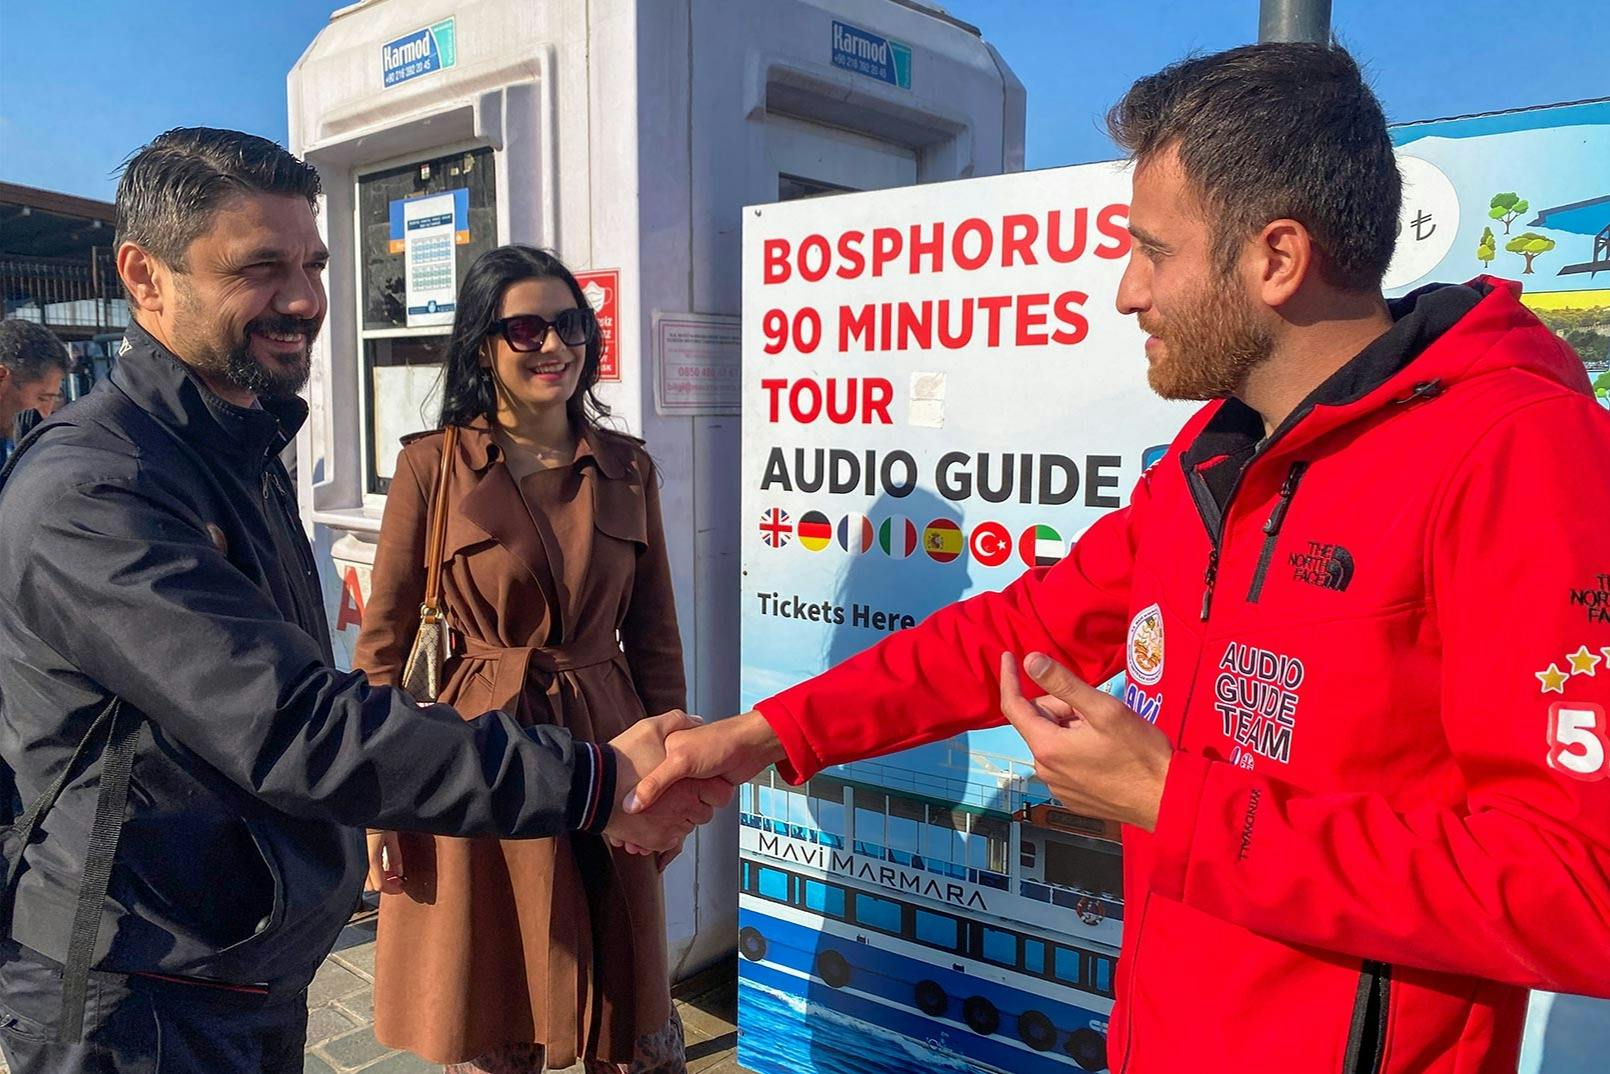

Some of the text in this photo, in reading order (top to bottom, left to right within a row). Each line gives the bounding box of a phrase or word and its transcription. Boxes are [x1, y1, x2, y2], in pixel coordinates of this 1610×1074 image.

[383, 31, 431, 72] Karmod
[833, 24, 887, 66] Karmod
[763, 204, 1132, 285] BOSPHORUS
[762, 290, 1090, 355] 90 MINUTES
[761, 377, 894, 425] TOUR
[760, 446, 1122, 508] AUDIO GUIDE
[757, 592, 915, 631] Tickets Here
[1219, 641, 1304, 690] AUDIO
[1215, 673, 1298, 727] GUIDE
[1214, 703, 1292, 764] TEAM
[832, 850, 987, 911] MARMARA
